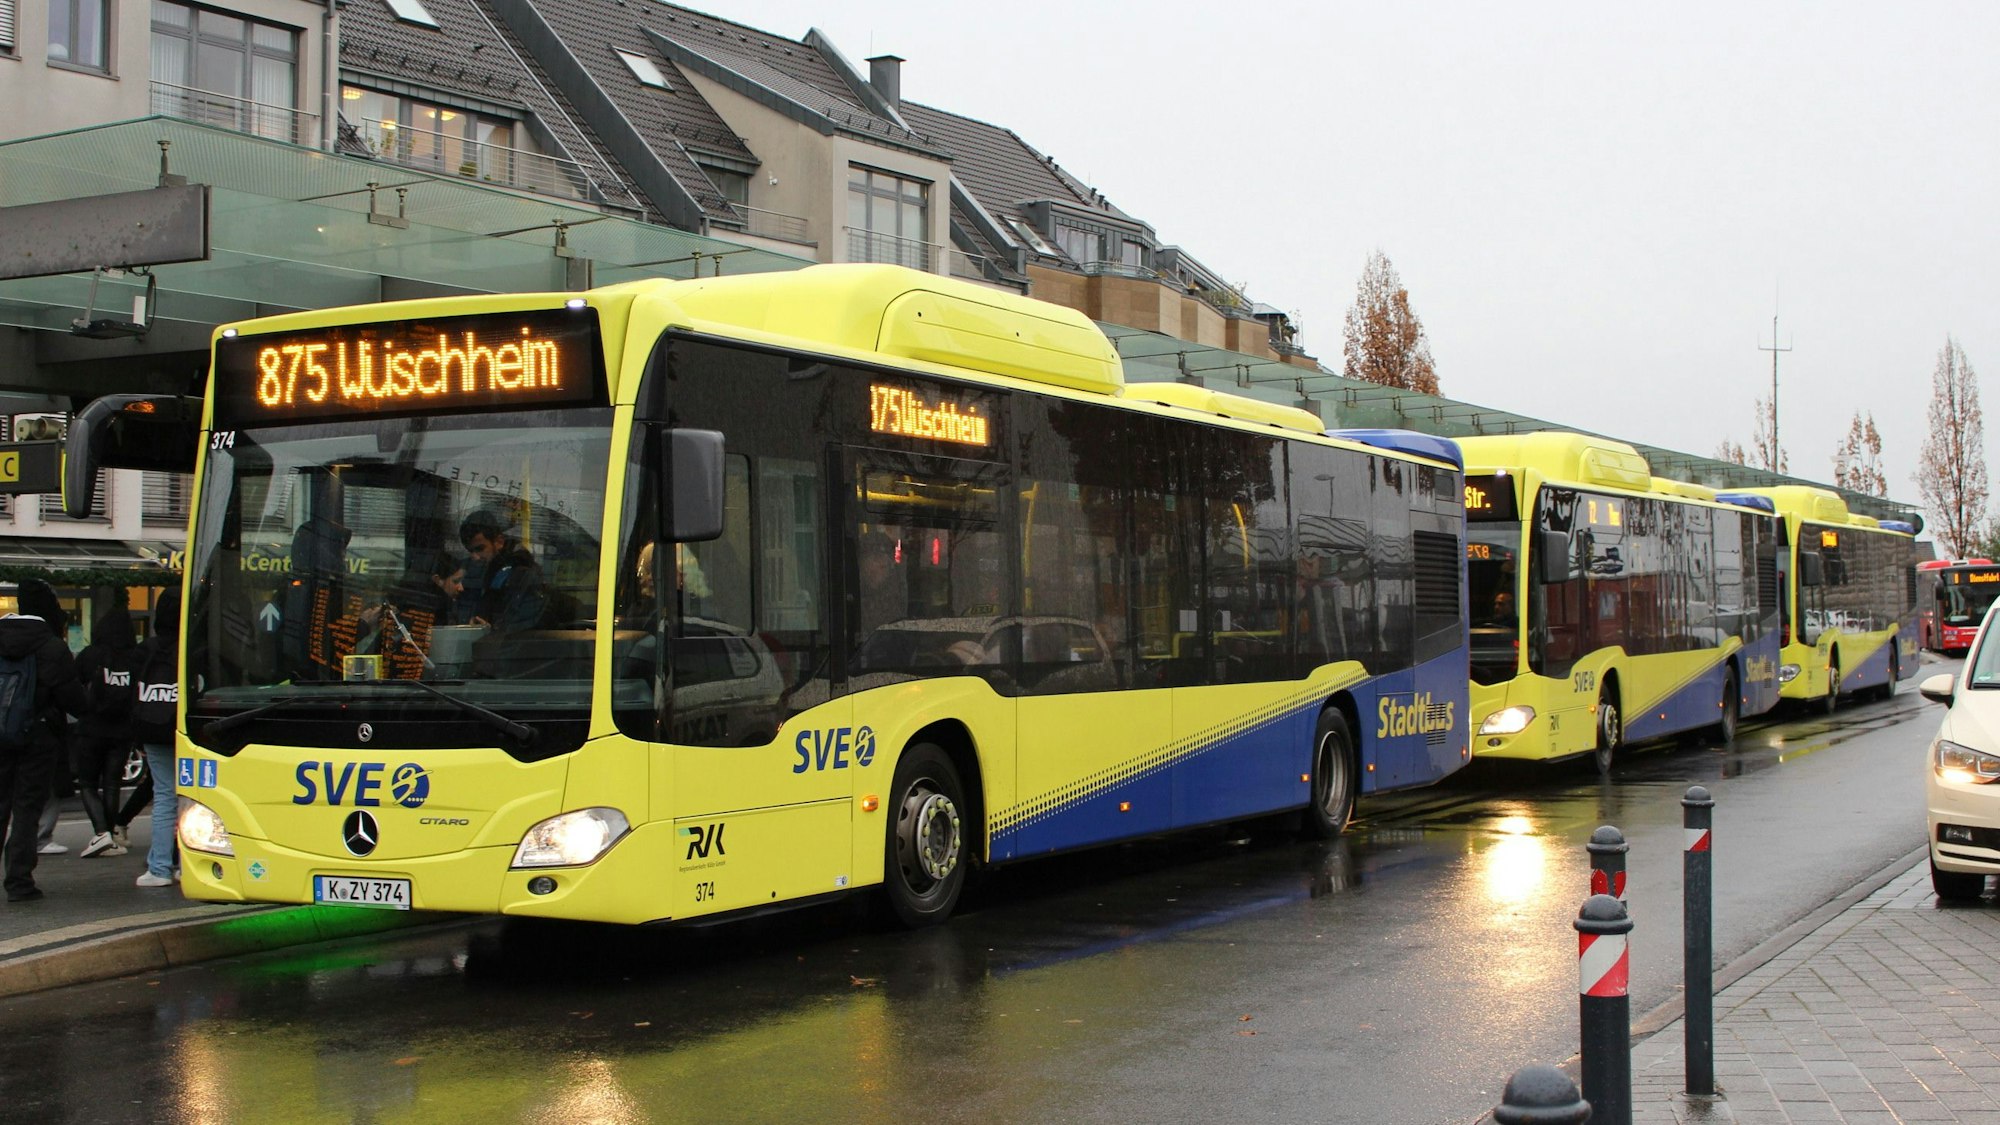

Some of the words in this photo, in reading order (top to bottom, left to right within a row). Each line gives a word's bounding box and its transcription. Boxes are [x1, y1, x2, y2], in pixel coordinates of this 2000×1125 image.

[259, 346, 328, 406] 875
[337, 327, 558, 399] Wüschheim
[901, 390, 986, 444] Wüschheim
[211, 431, 235, 449] 374
[4, 457, 15, 477] C
[1464, 486, 1492, 509] Str.
[104, 667, 131, 687] VAN
[1574, 671, 1588, 693] SVE
[138, 681, 179, 703] VANS
[1377, 691, 1454, 739] Stadtbus
[793, 727, 852, 774] SVE
[292, 760, 386, 807] SVE
[419, 817, 469, 826] CITARO
[329, 880, 338, 899] K
[350, 882, 369, 900] ZY
[373, 883, 403, 902] 374
[696, 881, 714, 902] 374
